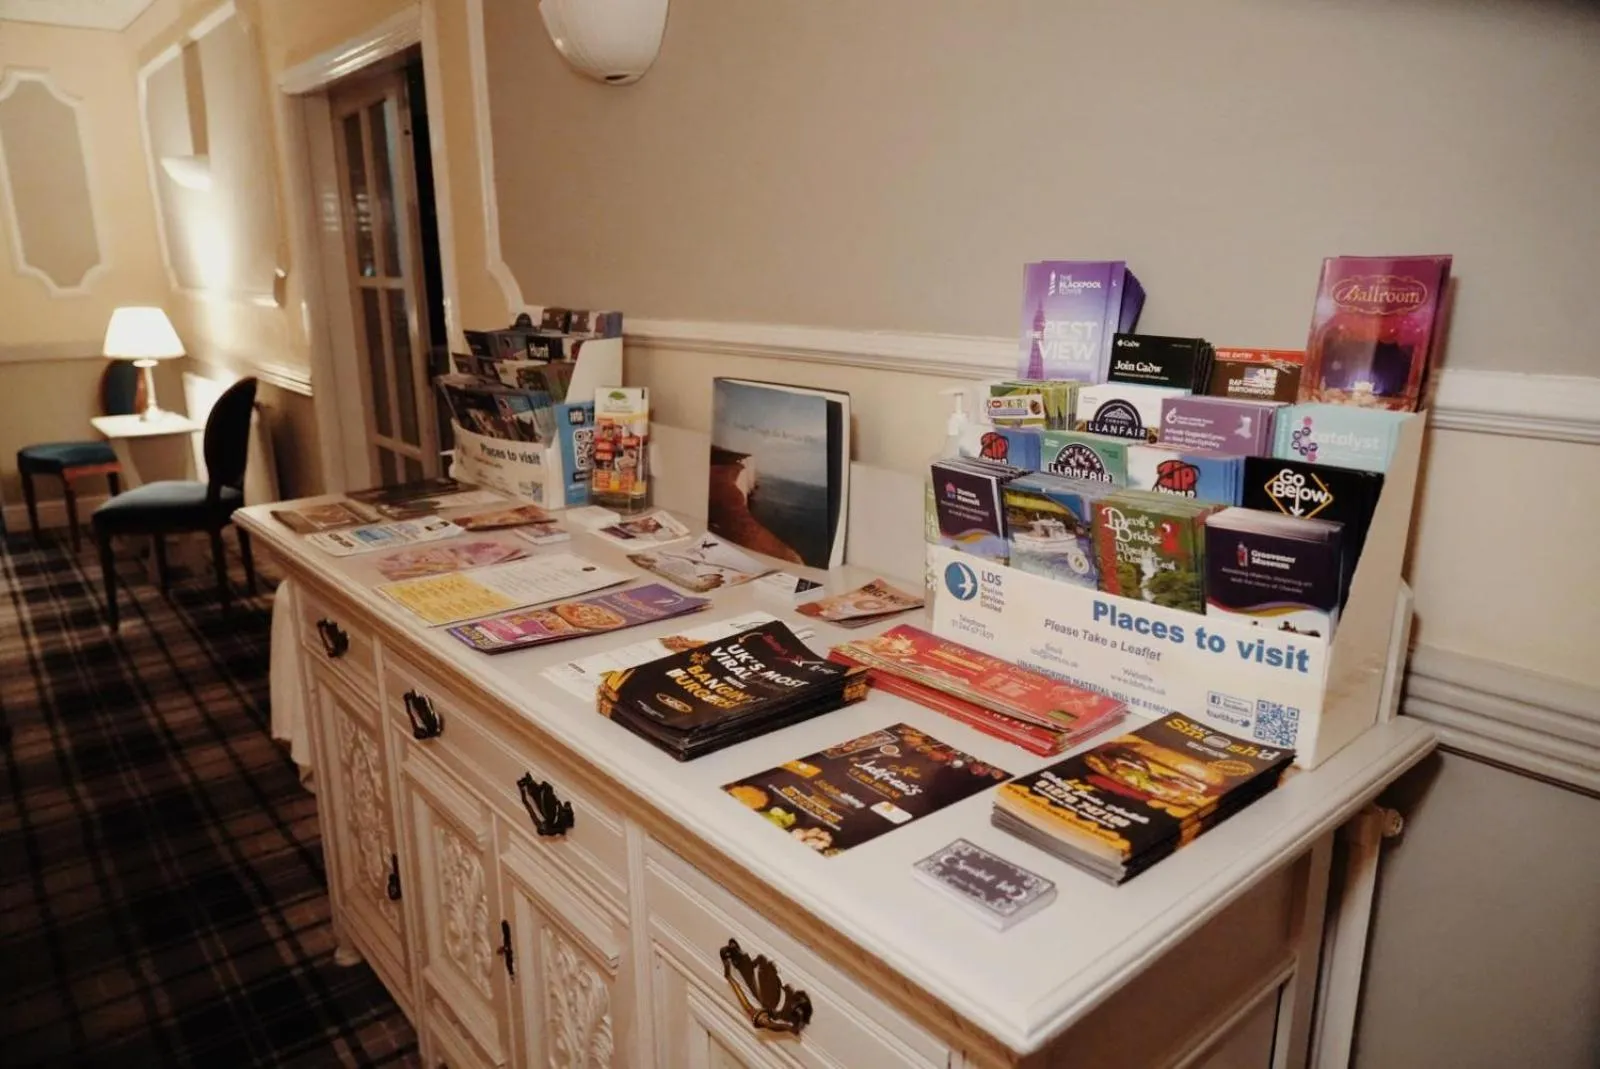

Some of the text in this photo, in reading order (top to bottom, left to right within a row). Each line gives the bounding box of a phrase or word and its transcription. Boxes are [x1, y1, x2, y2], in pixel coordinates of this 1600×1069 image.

[1060, 280, 1101, 289] BLACKPOOL
[1336, 284, 1420, 304] Ballroom
[1044, 320, 1098, 339] BEST
[1039, 340, 1097, 361] VIEW
[1114, 360, 1135, 371] Join
[1088, 422, 1147, 438] LLANFAIR
[1312, 431, 1380, 451] catalyst
[1051, 464, 1110, 483] LLANFAIR
[1157, 460, 1198, 490] ZIP
[1279, 468, 1305, 487] Go
[1272, 481, 1328, 504] Below
[1115, 519, 1162, 544] Bridge
[1251, 550, 1296, 564] Grosvenor
[1251, 557, 1291, 570] Museum
[981, 570, 1002, 586] LDS
[1044, 618, 1162, 662] Please Take a Leaflet
[1093, 599, 1310, 673] Places to visit
[710, 646, 752, 680] VIRAL
[727, 643, 766, 672] UK'S
[760, 669, 811, 689] MOST
